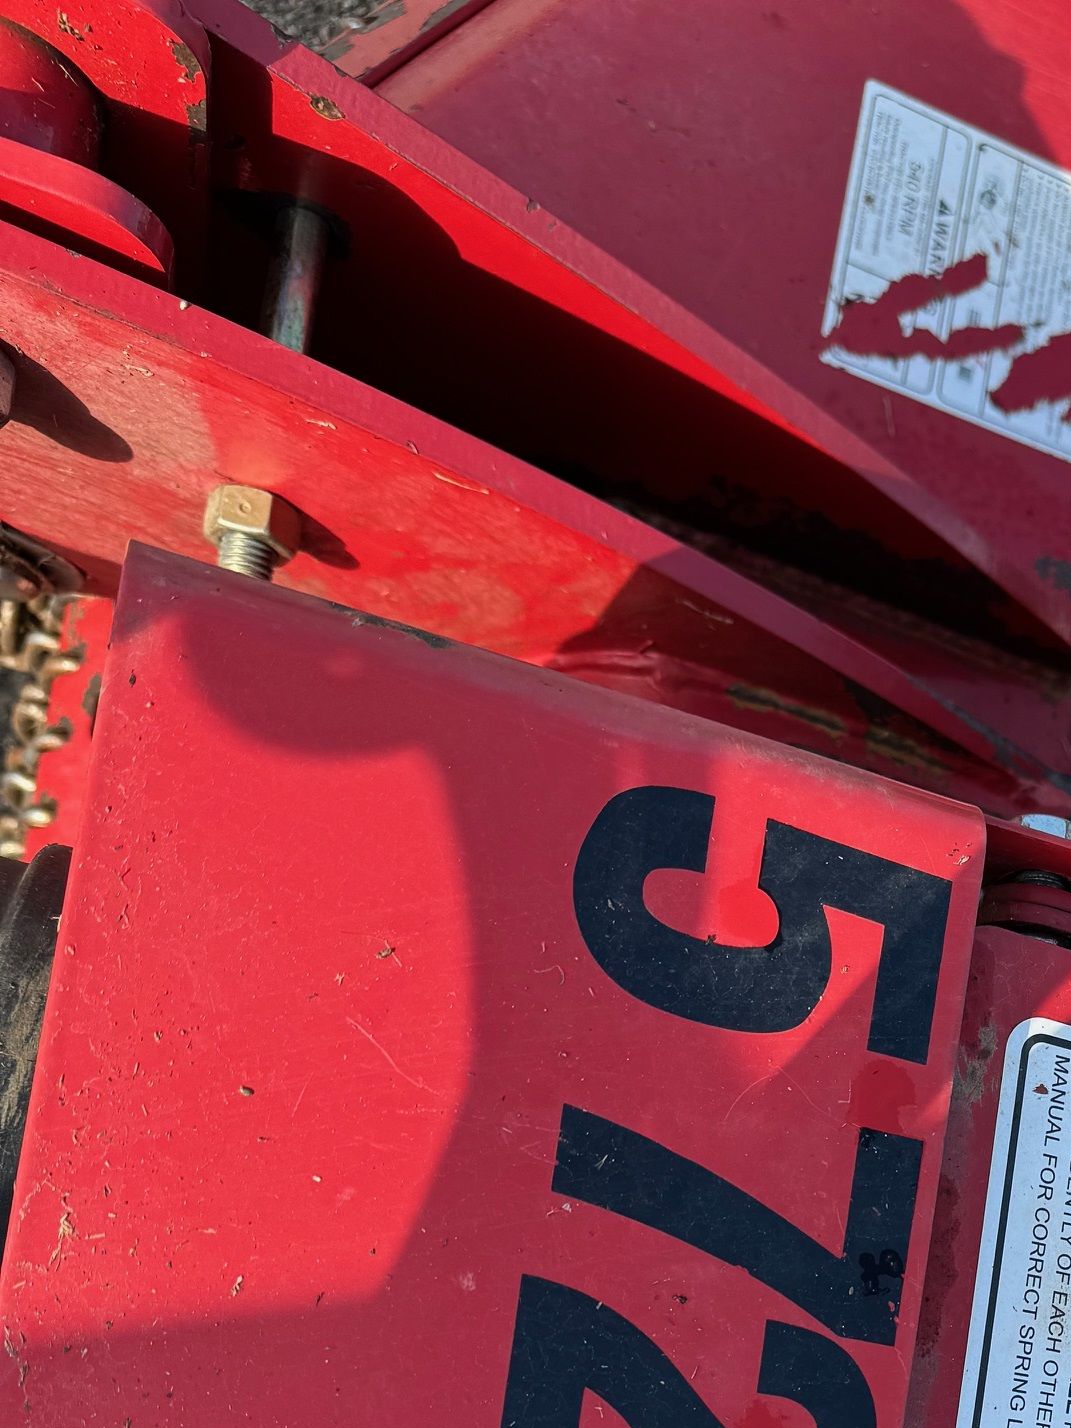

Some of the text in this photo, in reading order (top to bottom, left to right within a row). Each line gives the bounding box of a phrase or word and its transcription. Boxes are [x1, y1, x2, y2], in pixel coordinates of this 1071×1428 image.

[1044, 1054, 1071, 1147] MANUAL
[1036, 1153, 1058, 1201] FOR
[1022, 1207, 1051, 1321] CORRECT
[1045, 1290, 1069, 1354] EACH
[1009, 1324, 1036, 1412] SPRING
